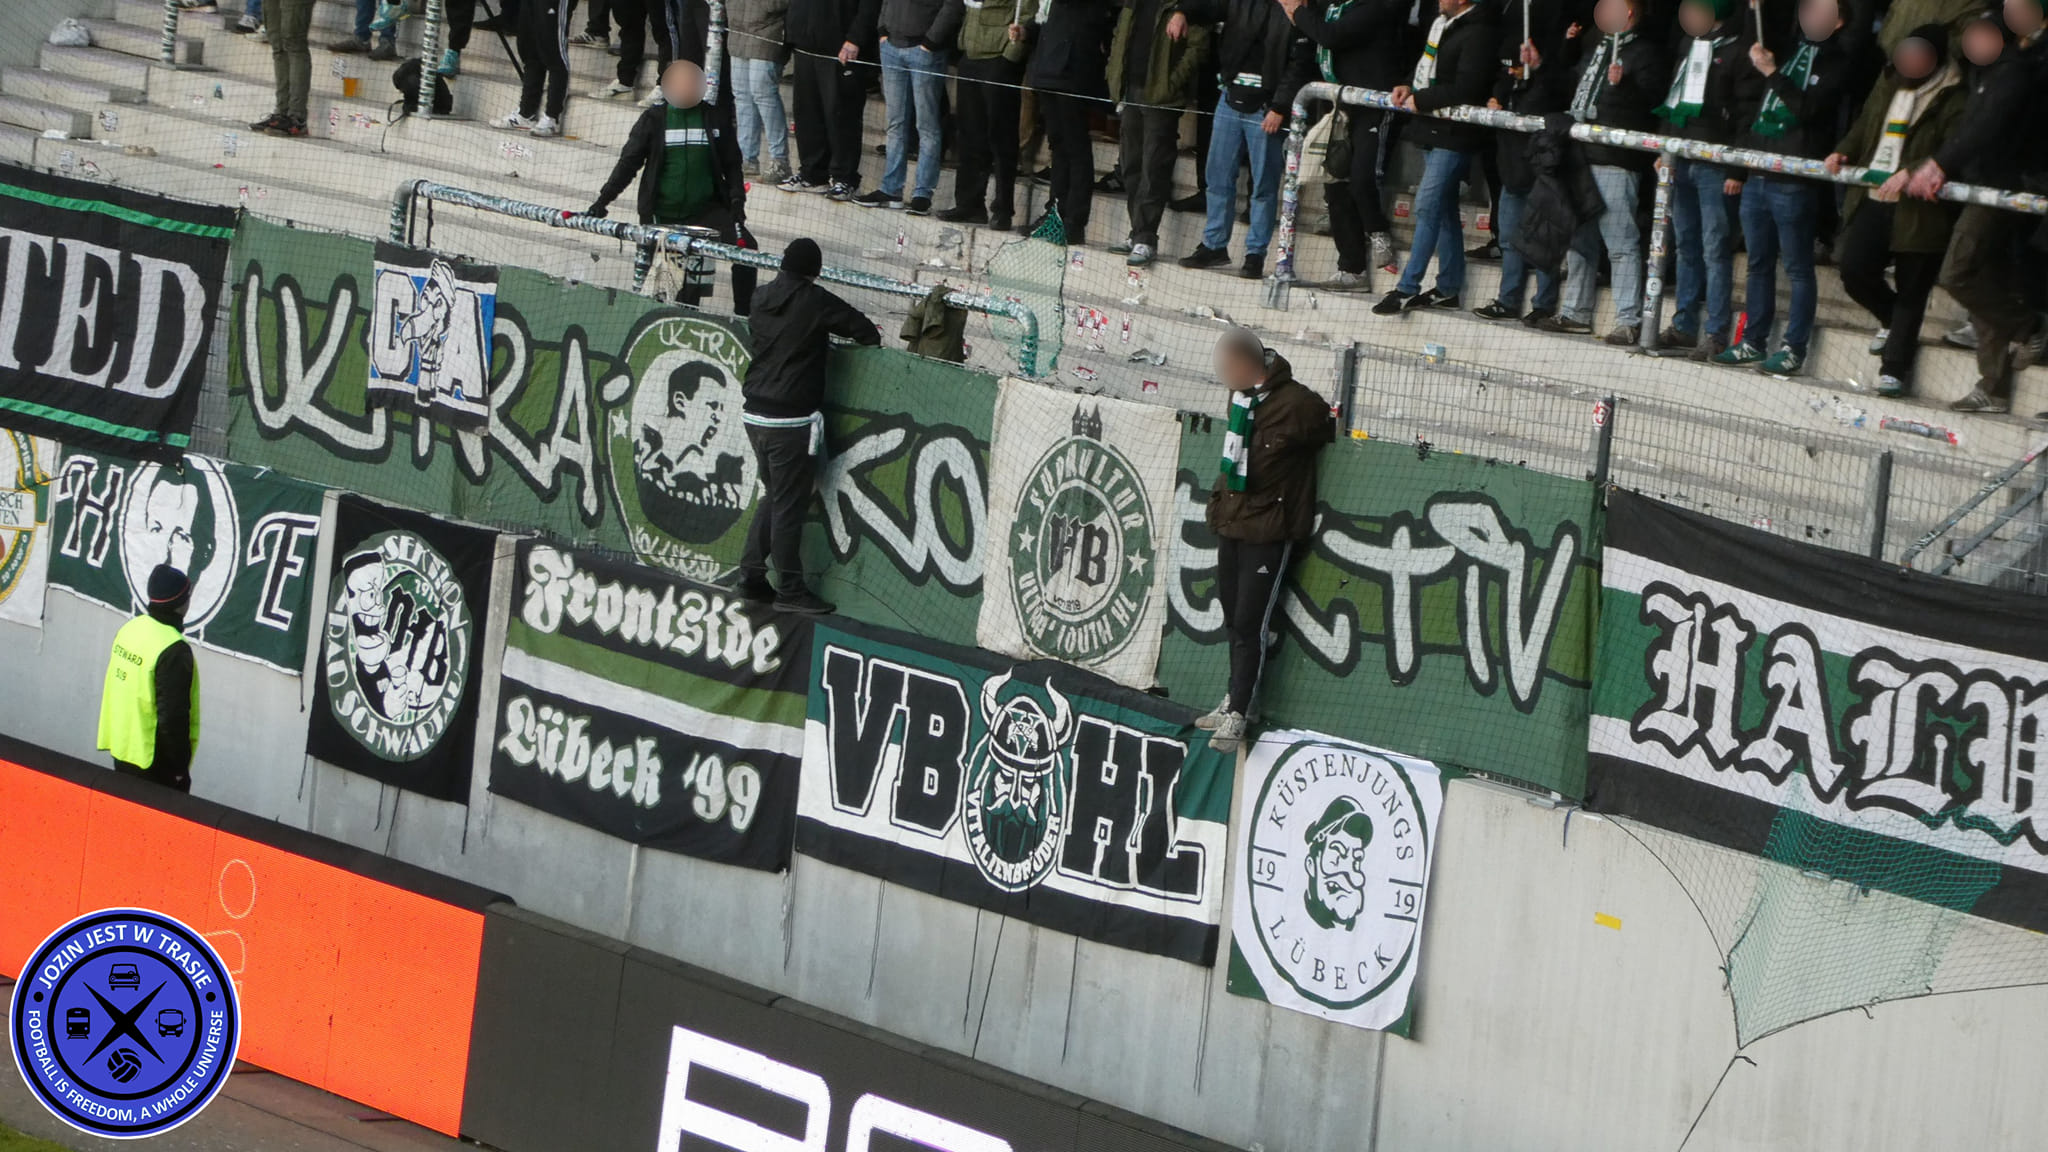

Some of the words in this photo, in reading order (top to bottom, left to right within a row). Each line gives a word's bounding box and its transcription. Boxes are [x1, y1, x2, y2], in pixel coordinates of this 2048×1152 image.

[113, 644, 143, 666] STEWARD
[498, 695, 663, 808] Lübeck
[967, 788, 1061, 884] VITALIENBRÜDER
[1269, 753, 1415, 861] KÜSTENJUNGS
[1255, 857, 1277, 881] 19
[1394, 889, 1416, 914] 19
[1269, 915, 1394, 991] LÜBECK
